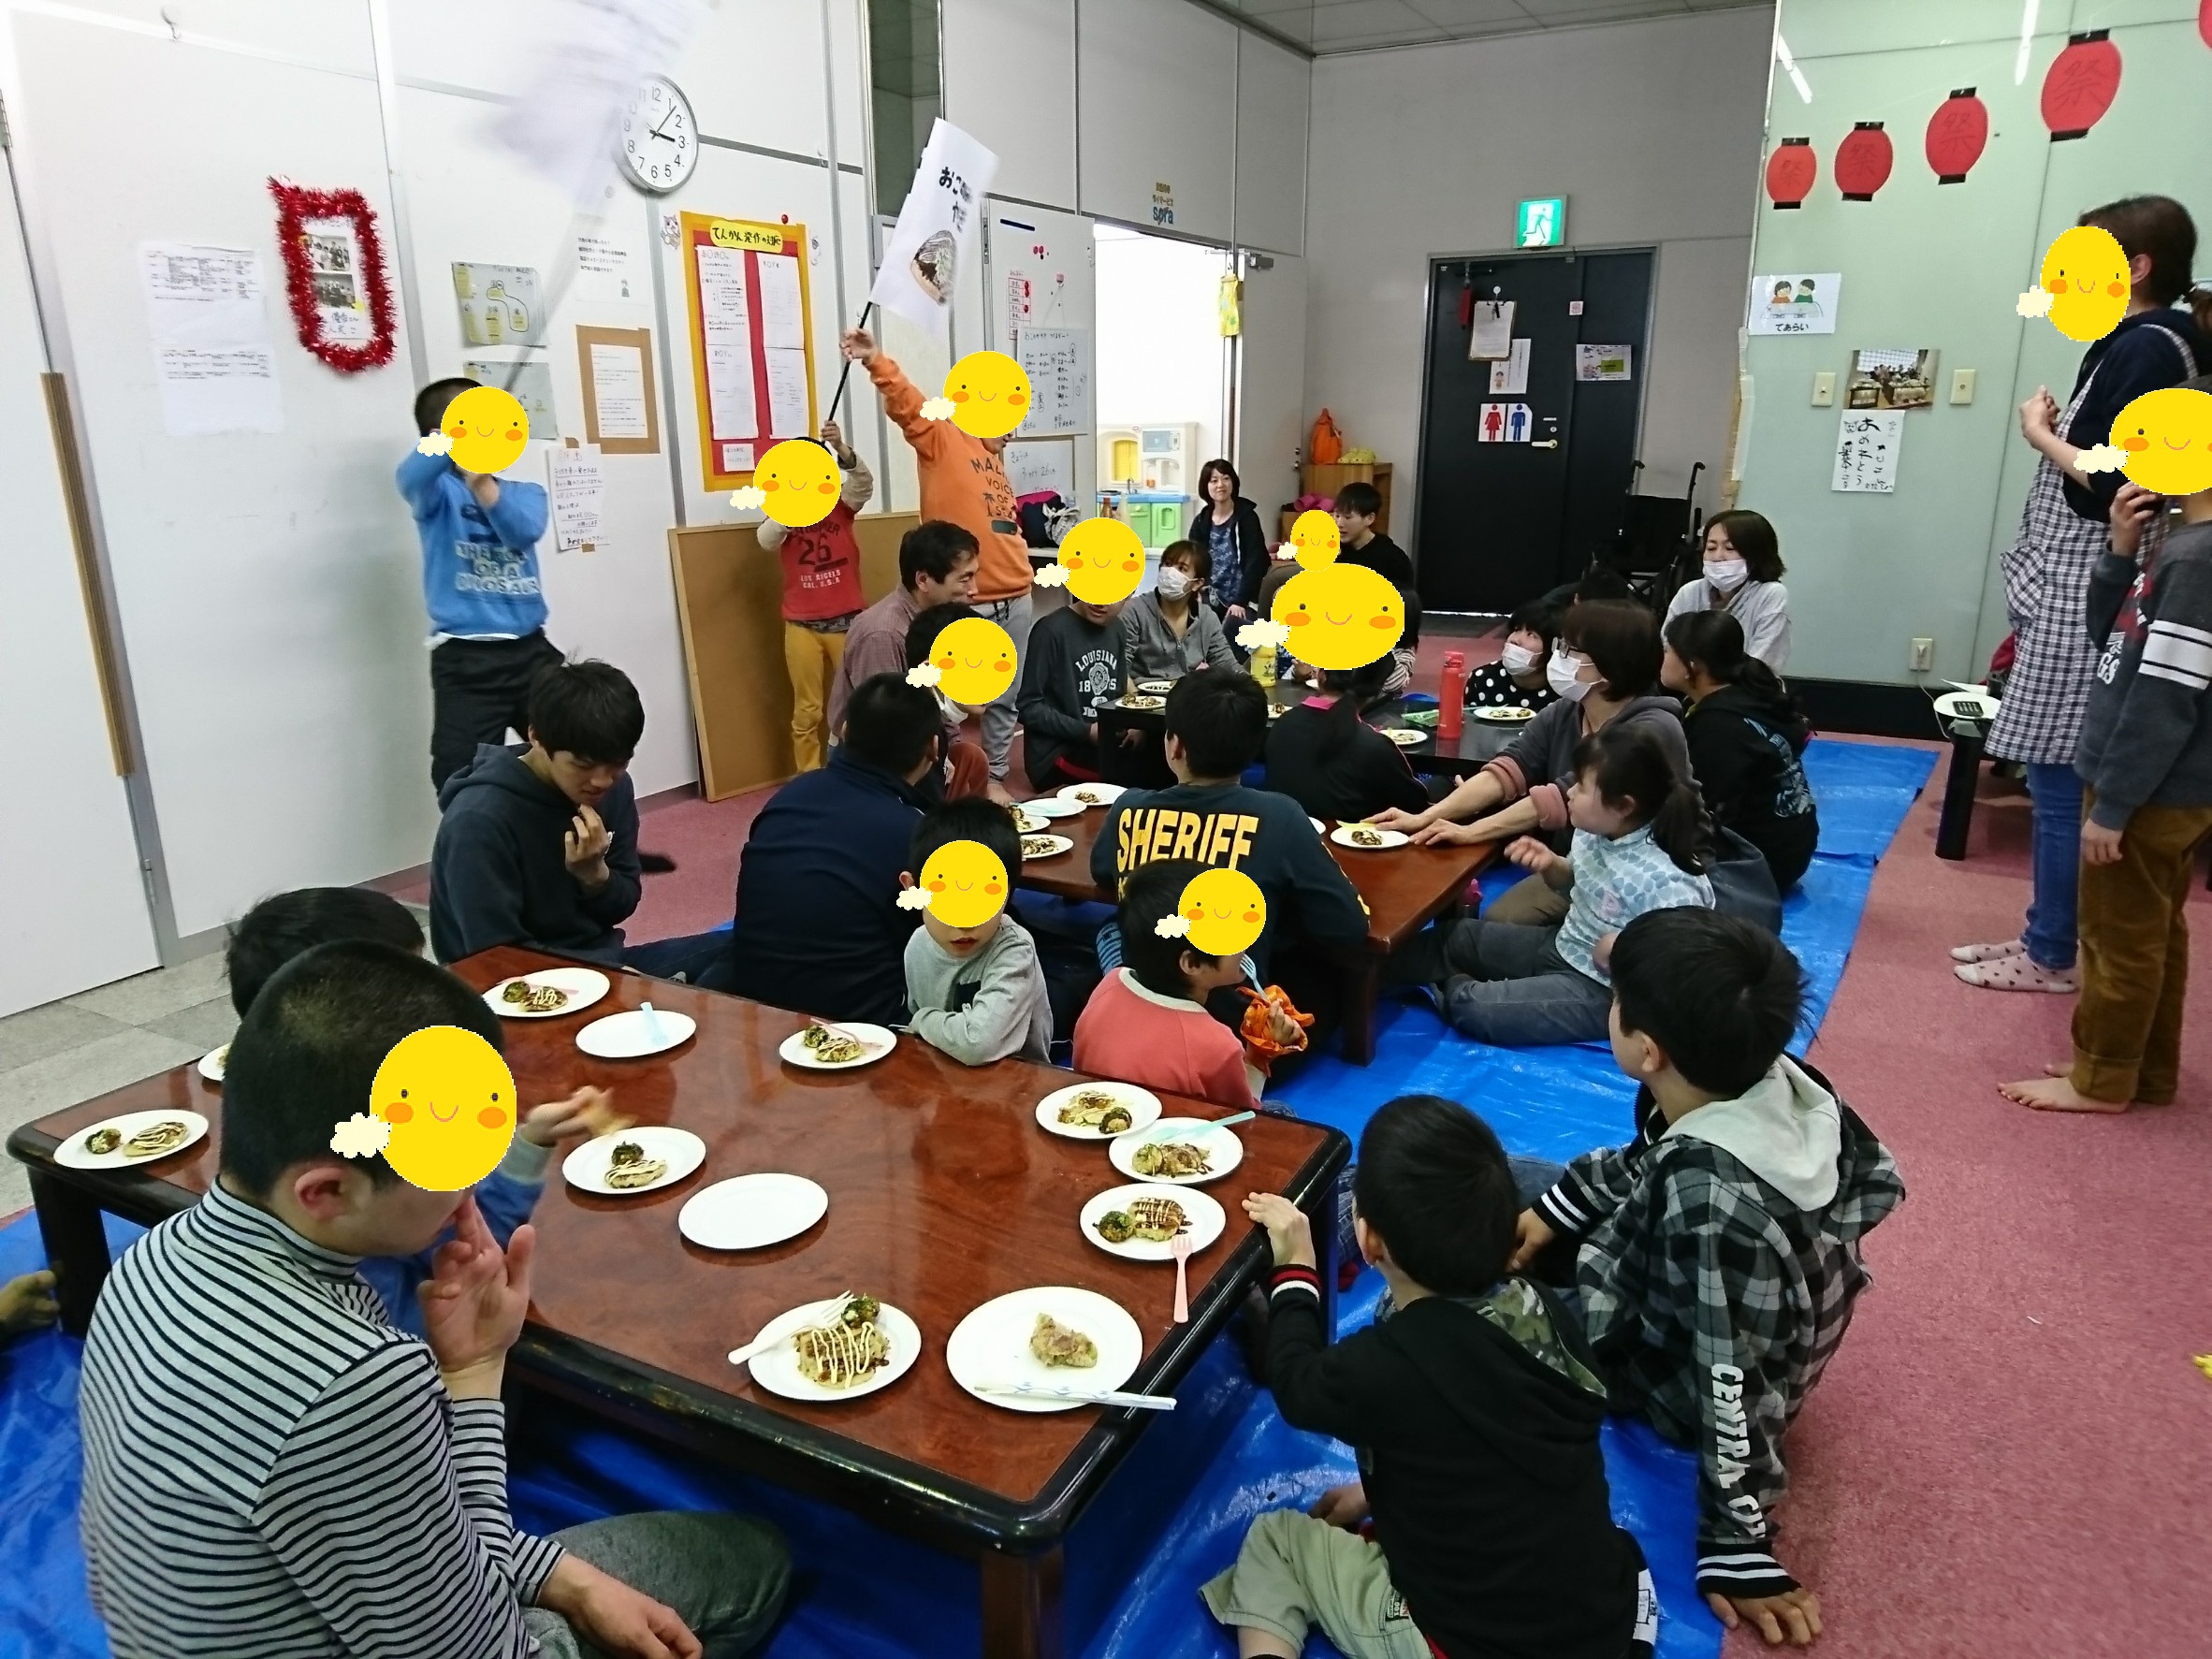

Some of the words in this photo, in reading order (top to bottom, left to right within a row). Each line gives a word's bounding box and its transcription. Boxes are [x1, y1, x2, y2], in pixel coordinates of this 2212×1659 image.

[2057, 58, 2107, 108] 祭
[651, 86, 662, 102] 12
[675, 114, 682, 128] 2
[1941, 112, 1975, 154] 祭
[627, 139, 635, 153] 8
[678, 136, 685, 149] 3
[638, 156, 645, 169] 7
[674, 154, 681, 167] 4
[650, 165, 658, 178] 6
[664, 164, 672, 178] 5
[712, 226, 781, 247] てんかん発作の対応
[1775, 323, 1809, 332] てあらい
[985, 476, 1013, 498] VOICE
[997, 494, 1009, 503] OF
[1075, 649, 1117, 672] LOUISIANA
[1078, 679, 1091, 692] 18
[1116, 807, 1259, 873] SHERIFF
[1711, 1363, 1751, 1490] CENTRAL
